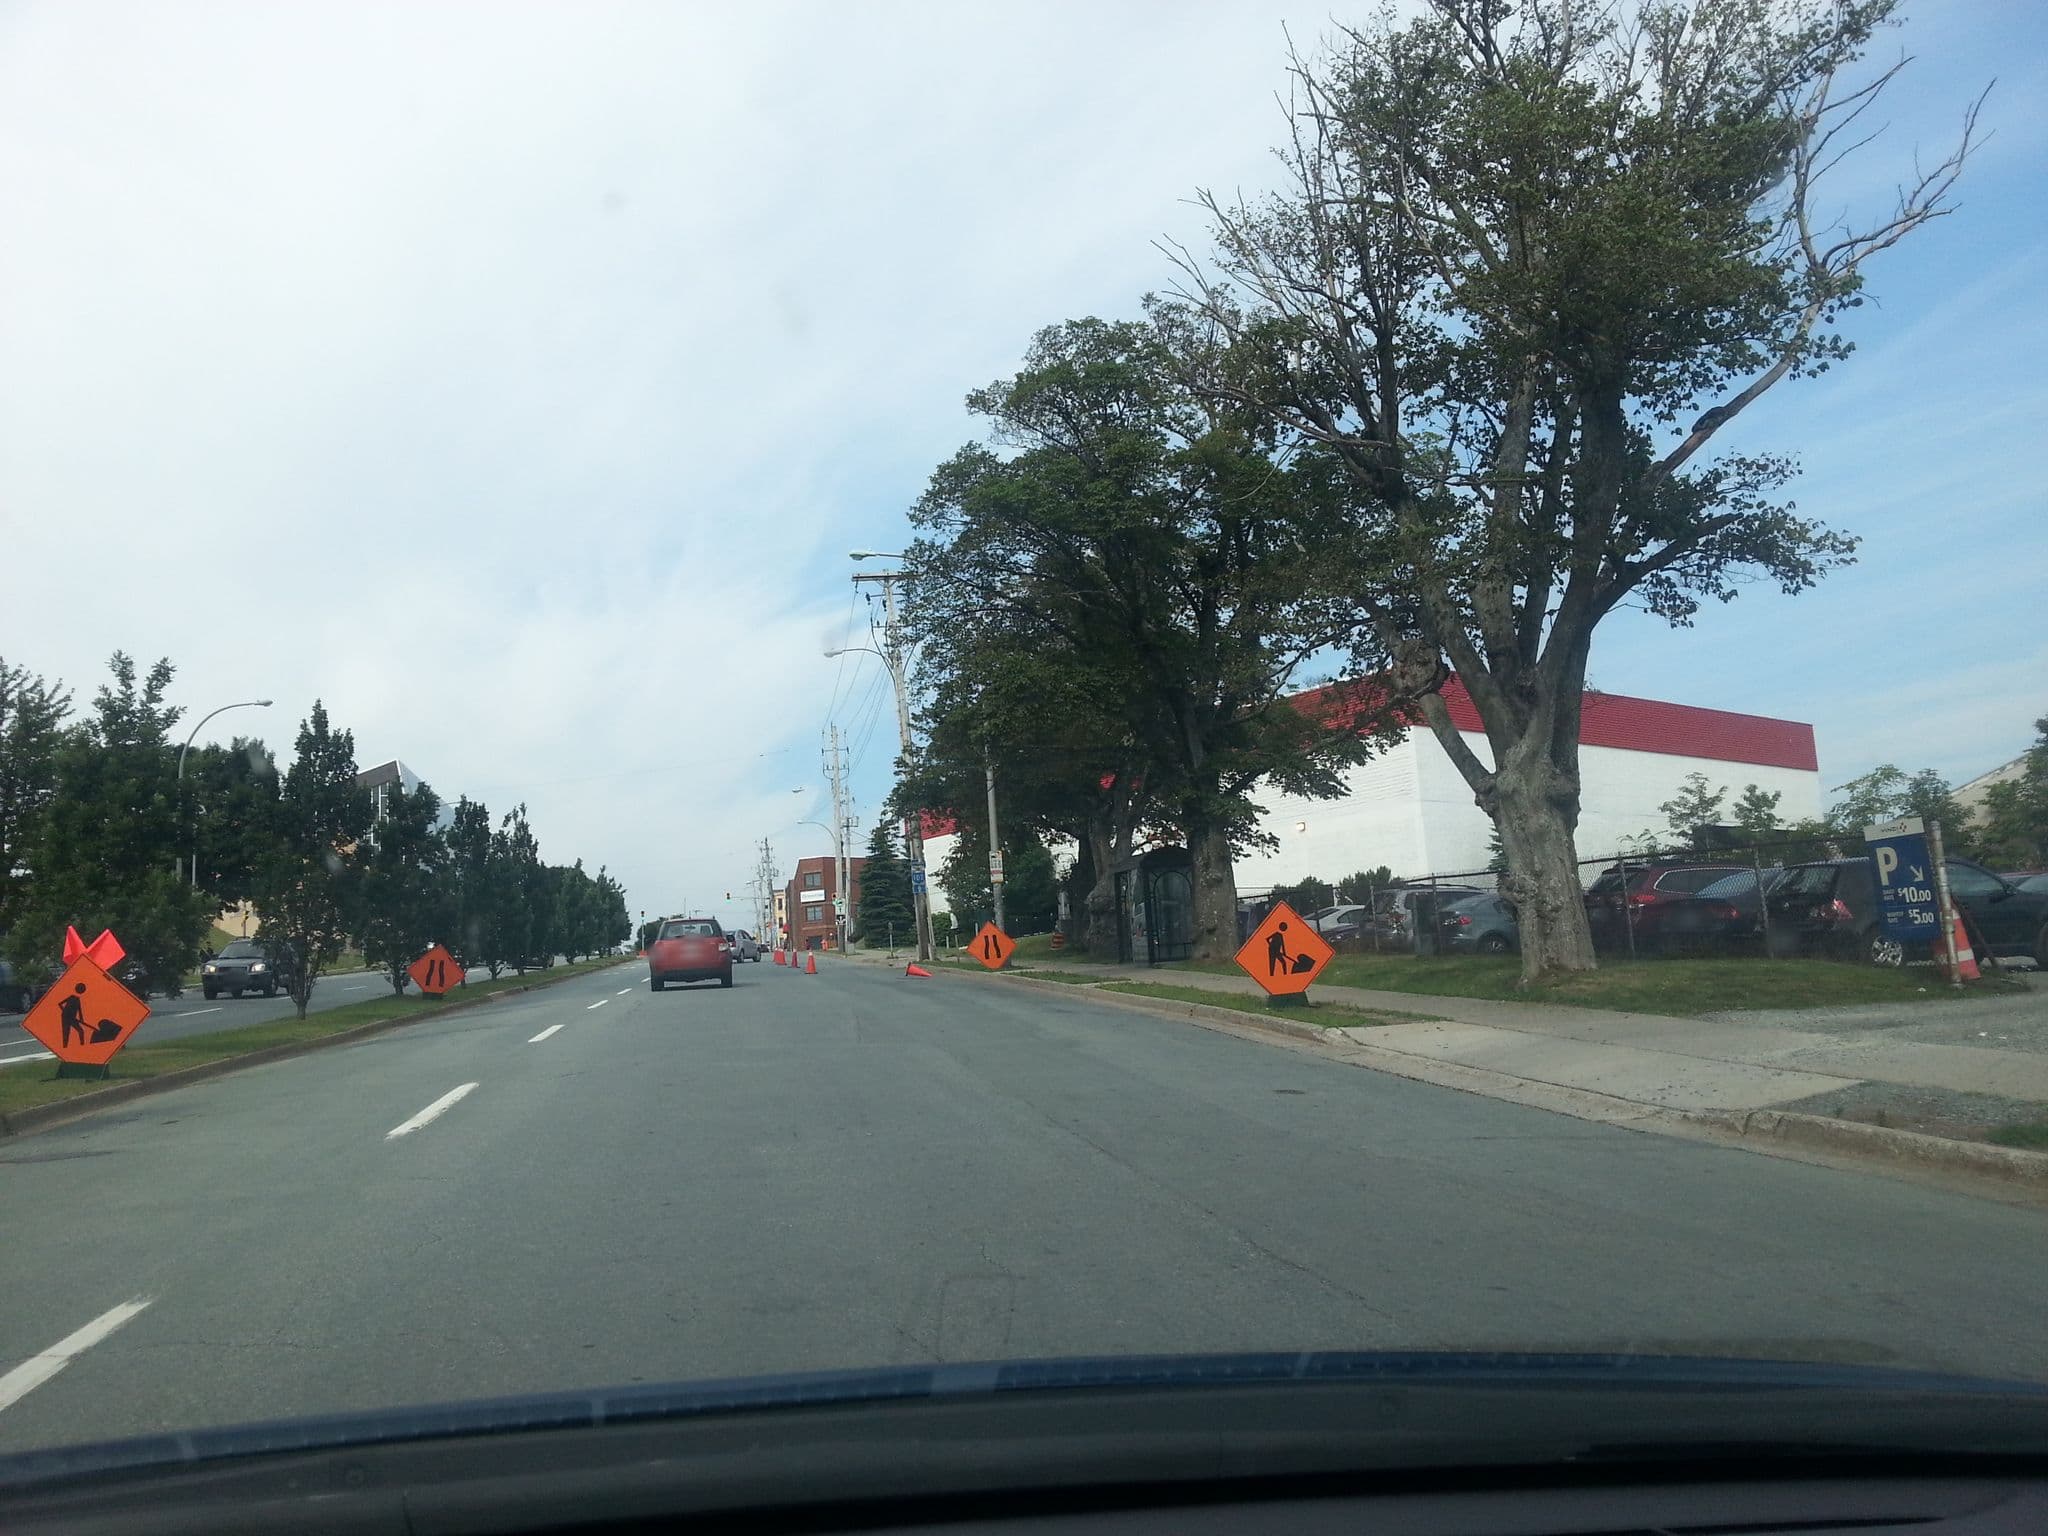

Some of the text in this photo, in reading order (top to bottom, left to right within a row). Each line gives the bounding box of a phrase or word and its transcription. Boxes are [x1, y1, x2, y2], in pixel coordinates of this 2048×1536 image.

[1876, 847, 1898, 886] P
[1898, 887, 1931, 903] $10.00
[1909, 909, 1934, 924] $5.00
